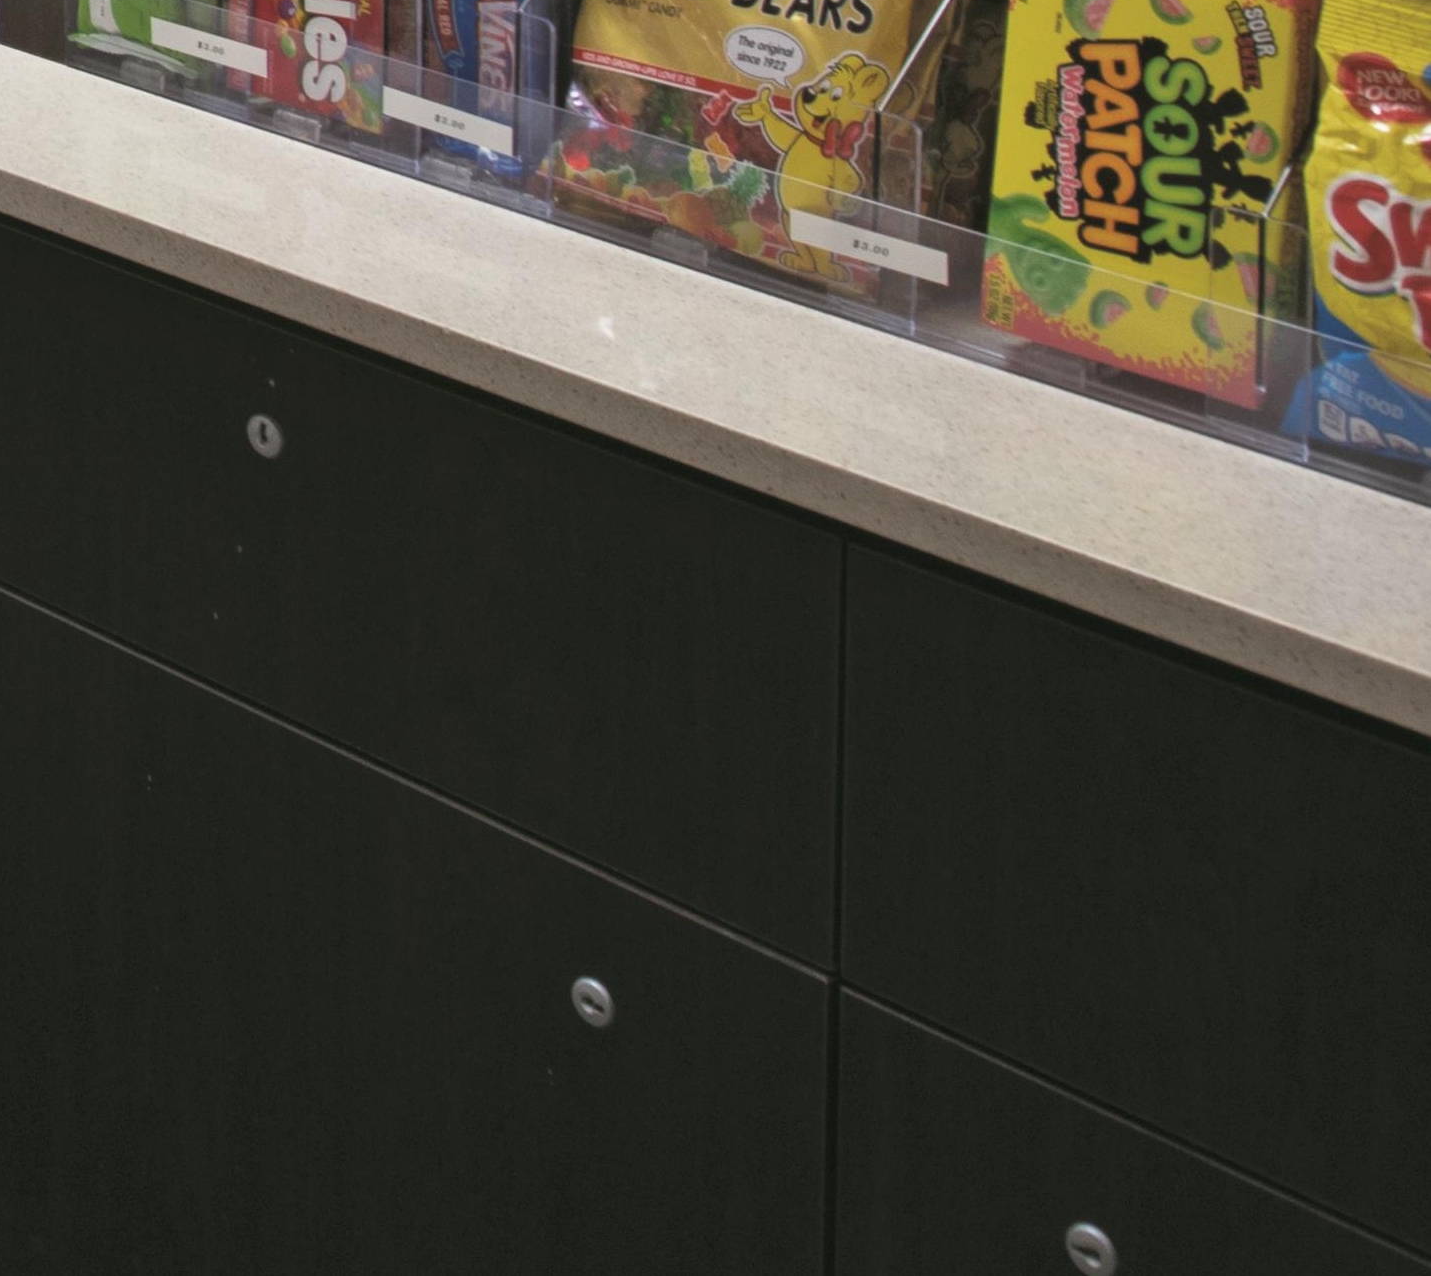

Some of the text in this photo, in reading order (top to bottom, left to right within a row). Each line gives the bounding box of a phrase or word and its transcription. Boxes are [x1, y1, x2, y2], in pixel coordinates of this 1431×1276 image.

[441, 17, 453, 37] RED
[738, 33, 795, 60] The original
[1243, 5, 1279, 59] SOUR
[735, 49, 788, 73] since 1922
[1356, 67, 1405, 88] NEW
[1057, 63, 1087, 220] Watermelon
[1080, 39, 1147, 256] PATCH
[1141, 55, 1208, 258] SOUR
